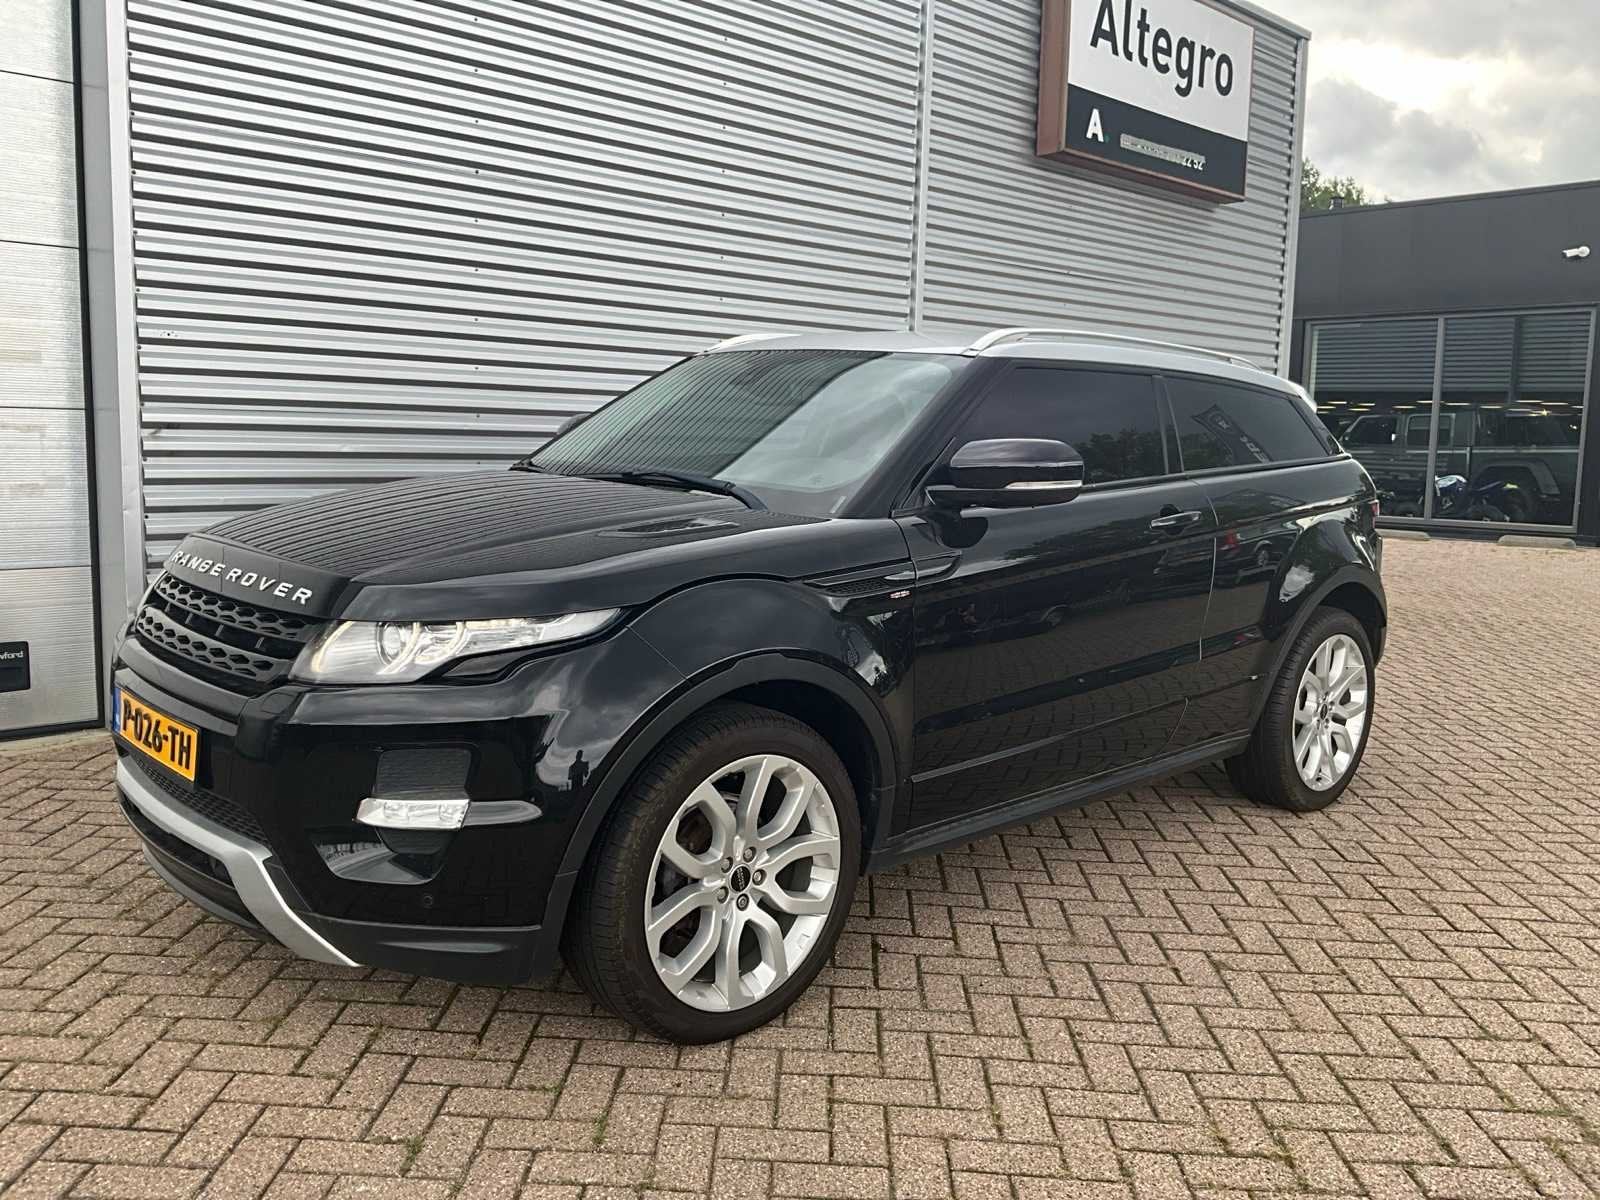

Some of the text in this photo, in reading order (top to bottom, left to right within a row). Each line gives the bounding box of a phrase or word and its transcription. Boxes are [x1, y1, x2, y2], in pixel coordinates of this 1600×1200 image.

[1090, 0, 1234, 97] Altegro
[171, 550, 313, 605] RANGE ROVER
[123, 698, 192, 770] P-026-TH
